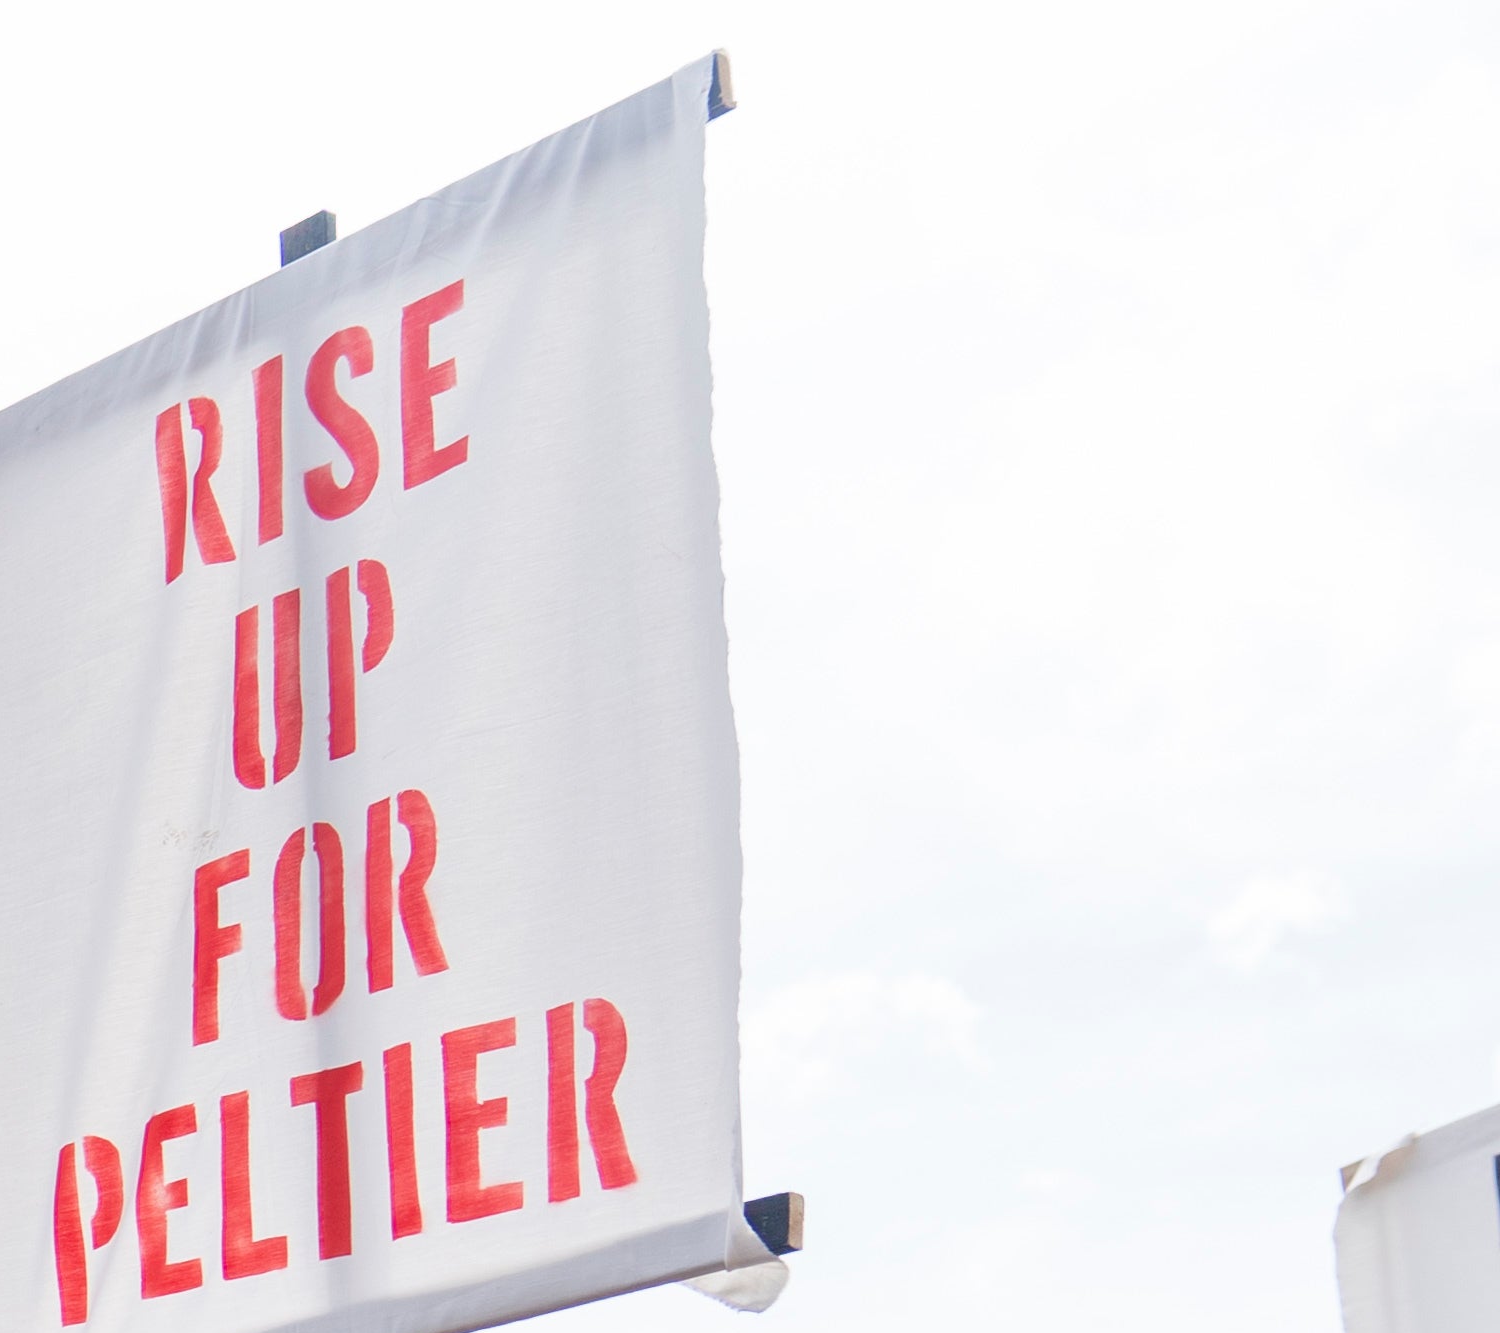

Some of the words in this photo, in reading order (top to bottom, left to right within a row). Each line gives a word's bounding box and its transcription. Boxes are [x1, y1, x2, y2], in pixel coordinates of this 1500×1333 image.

[154, 278, 470, 587] RISE
[231, 557, 396, 791] UP
[192, 789, 450, 1048] FOR
[53, 996, 639, 1327] PELTIER
